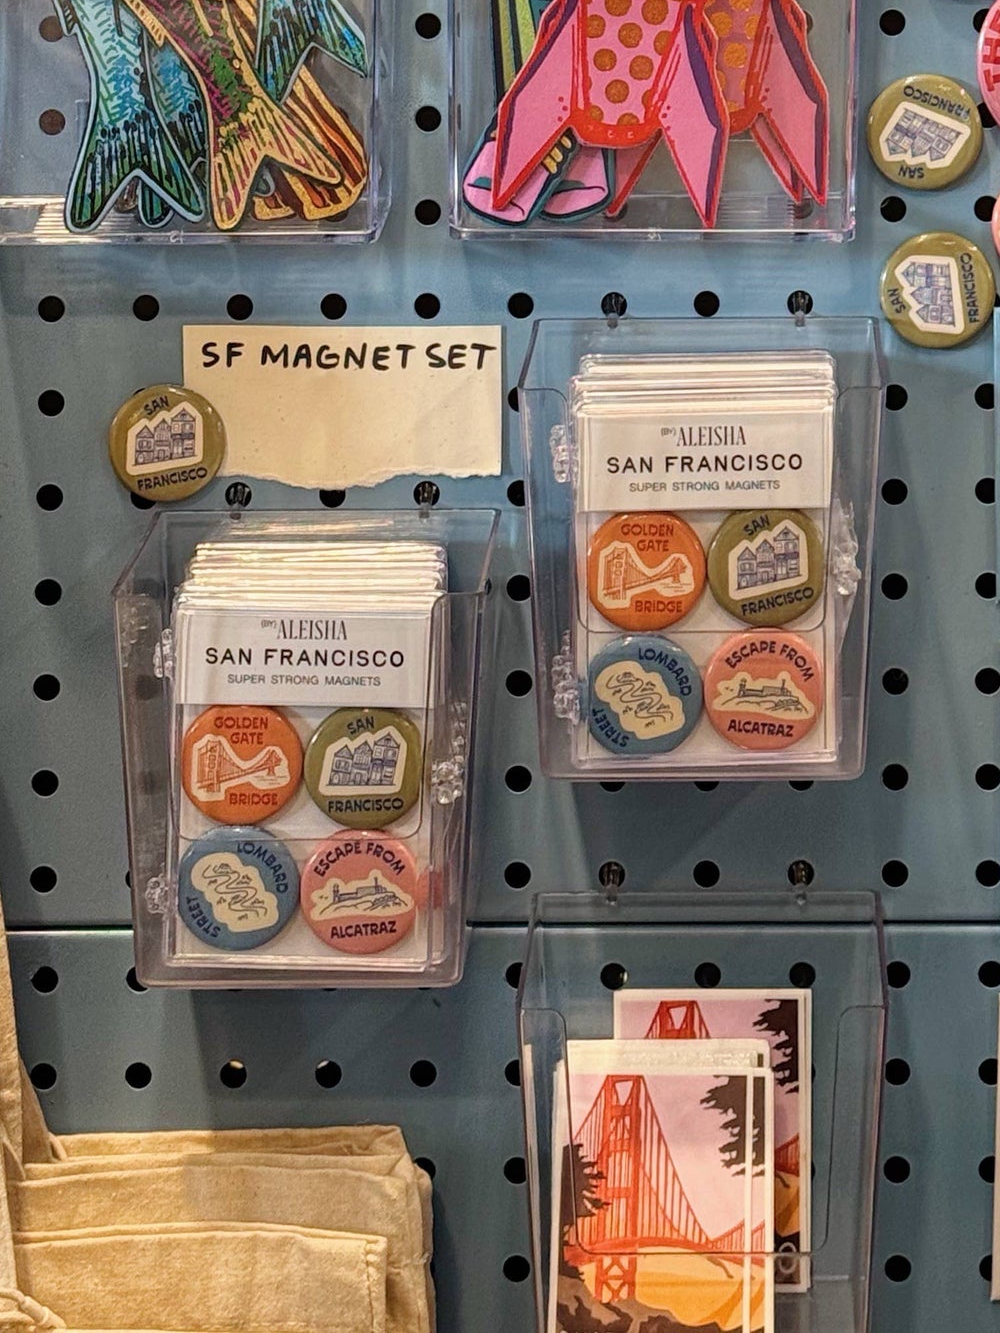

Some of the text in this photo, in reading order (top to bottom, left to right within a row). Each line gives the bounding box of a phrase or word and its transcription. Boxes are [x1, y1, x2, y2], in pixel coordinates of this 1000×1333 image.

[201, 341, 497, 371] SF MAGNET SET
[144, 396, 168, 416] SAN
[676, 425, 746, 446] ALEISHA
[607, 454, 802, 473] SAN FRANCISCO
[137, 466, 208, 492] FRANCISCO
[629, 479, 780, 492] SUPER STRONG MAGNETS
[620, 524, 674, 536] GOLDEN
[743, 516, 770, 536] SAN
[637, 539, 669, 552] GATE
[634, 601, 683, 613] BRIDGE
[740, 586, 814, 615] FRANCISCO
[276, 620, 347, 640] ALEISHA
[205, 648, 404, 667] SAN FRANCISCO
[724, 641, 813, 682] ESCAPE FROM
[228, 674, 381, 686] SUPER STRONG MAGNETS
[637, 646, 692, 697] LOMBARD
[213, 716, 268, 730] GOLDEN
[347, 716, 375, 734] SAN
[591, 707, 631, 747] STREET
[727, 719, 793, 738] ALCATRAZ
[230, 731, 263, 745] GATE
[228, 793, 278, 805] BRIDGE
[327, 797, 403, 813] FRANCISCO
[313, 841, 406, 877] ESCAPE FROM
[330, 920, 397, 938] ALCATRAZ
